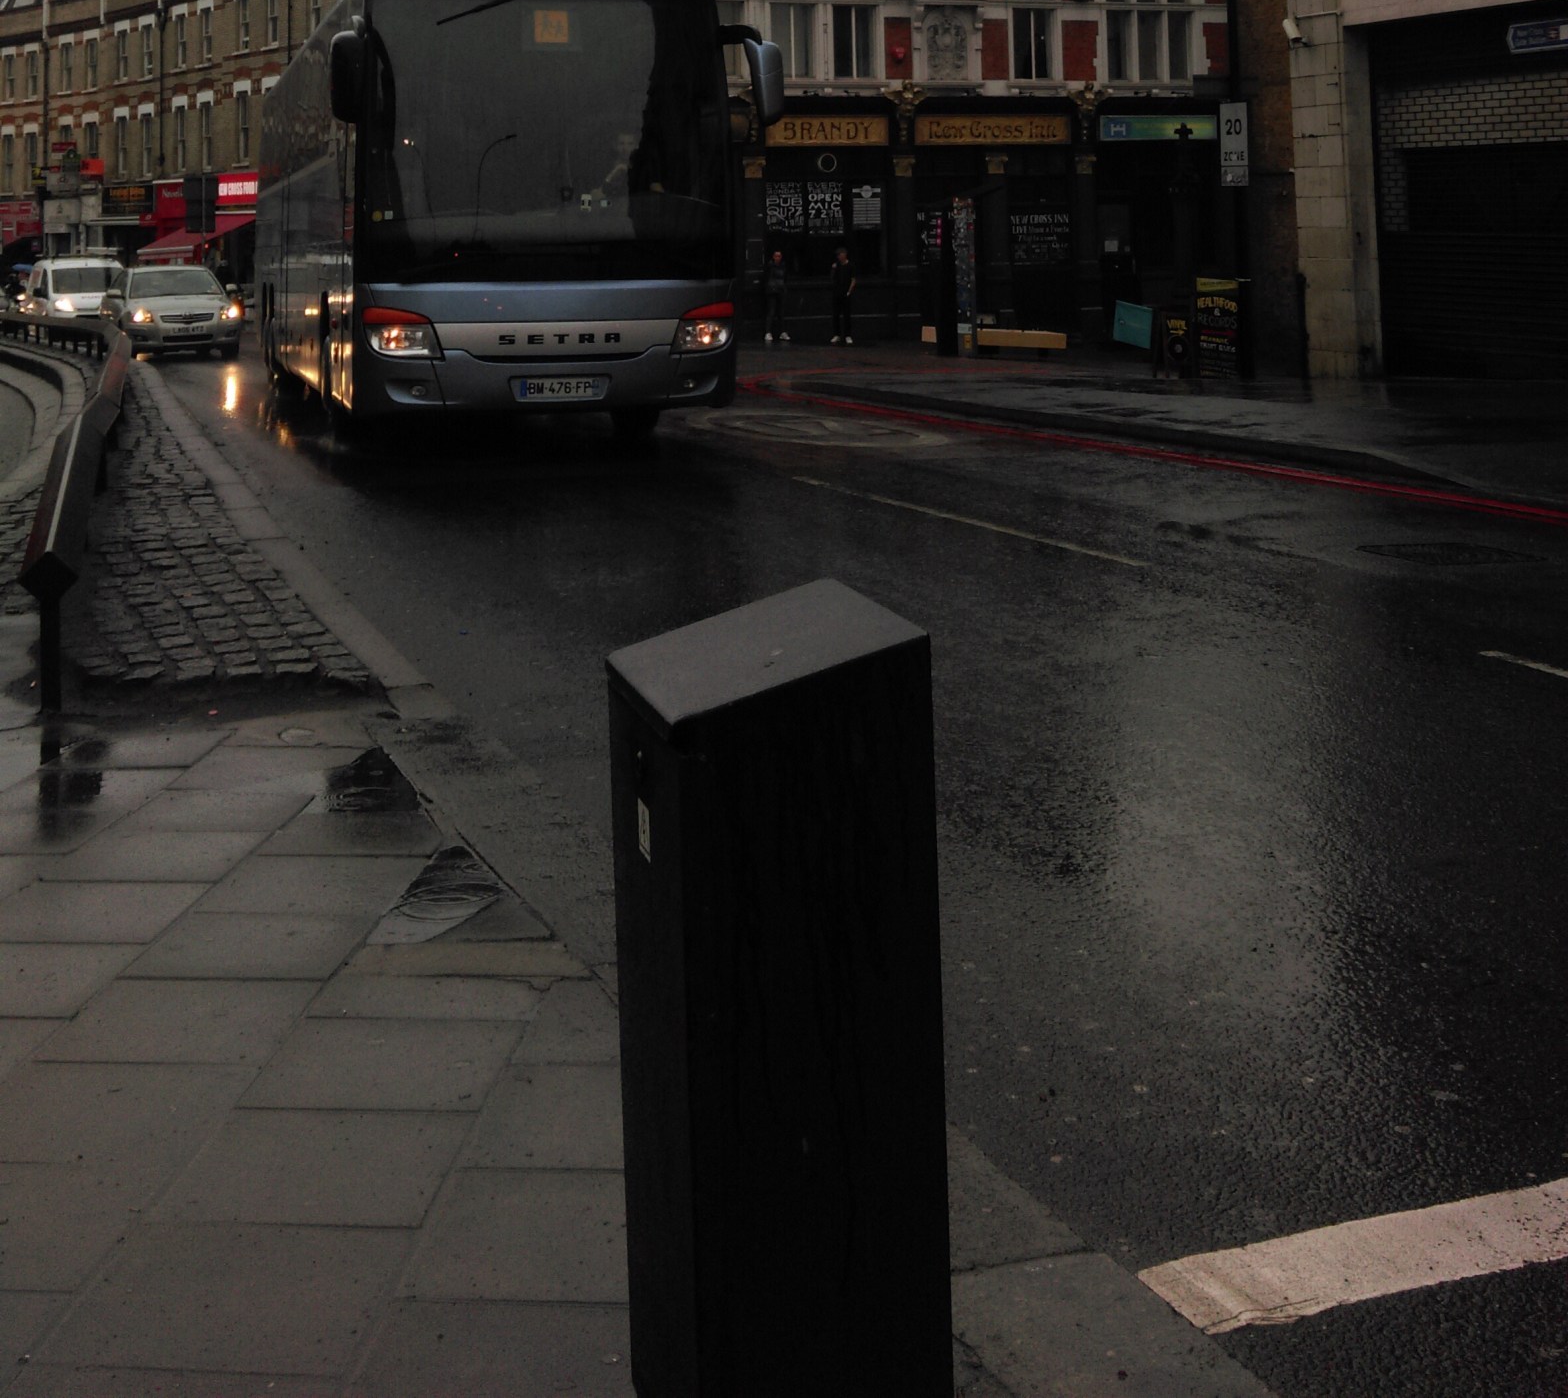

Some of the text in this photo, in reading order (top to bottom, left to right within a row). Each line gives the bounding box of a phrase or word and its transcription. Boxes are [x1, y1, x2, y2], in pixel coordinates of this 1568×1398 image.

[784, 121, 873, 140] BRANDY
[929, 120, 1057, 139] New Cross Inn
[1225, 118, 1242, 135] 20
[766, 198, 803, 207] PUB
[808, 193, 842, 201] OPEN
[808, 201, 841, 210] MIC
[1010, 213, 1069, 224] NEW CROSS INN
[1197, 296, 1238, 313] HEALTHFOOD
[1213, 307, 1221, 316] &
[1197, 312, 1238, 329] RECORDS
[499, 333, 621, 345] SETRA
